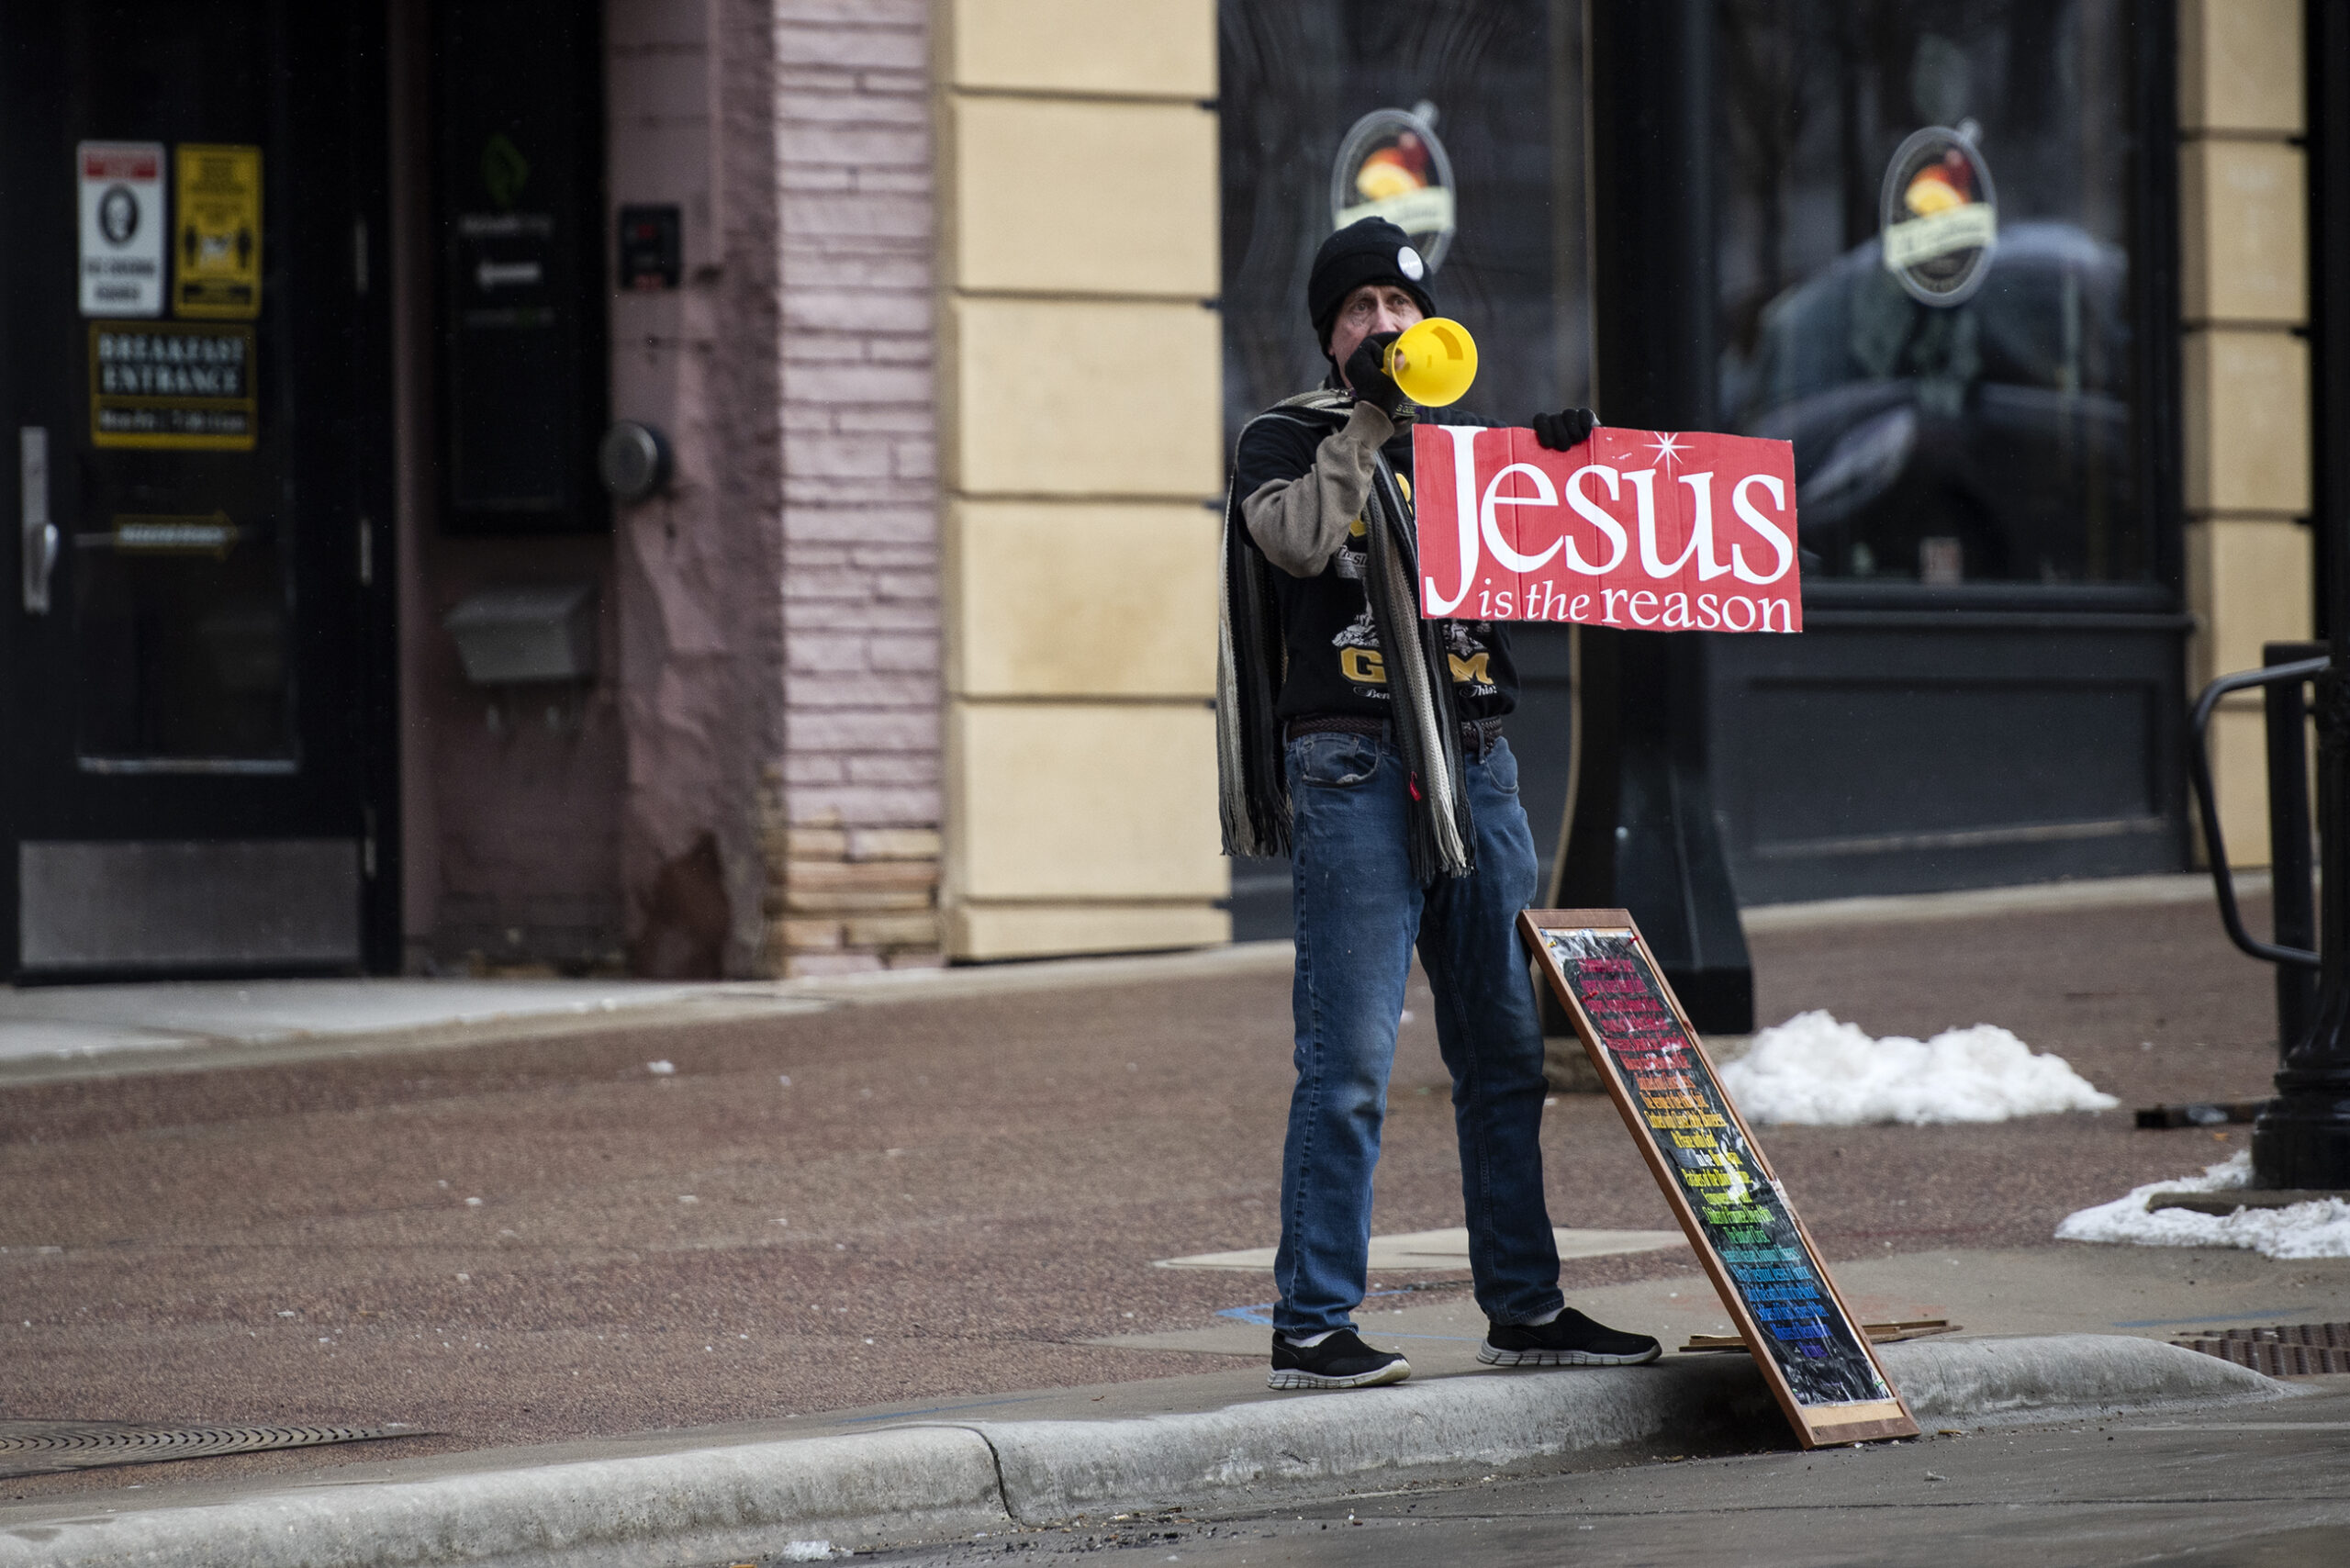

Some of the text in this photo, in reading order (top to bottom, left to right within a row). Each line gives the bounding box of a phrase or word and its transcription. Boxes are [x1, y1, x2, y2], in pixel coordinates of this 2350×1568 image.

[103, 364, 239, 394] ENTRANCE
[1426, 425, 1794, 616] Jesus
[1479, 578, 1792, 633] is the reason
